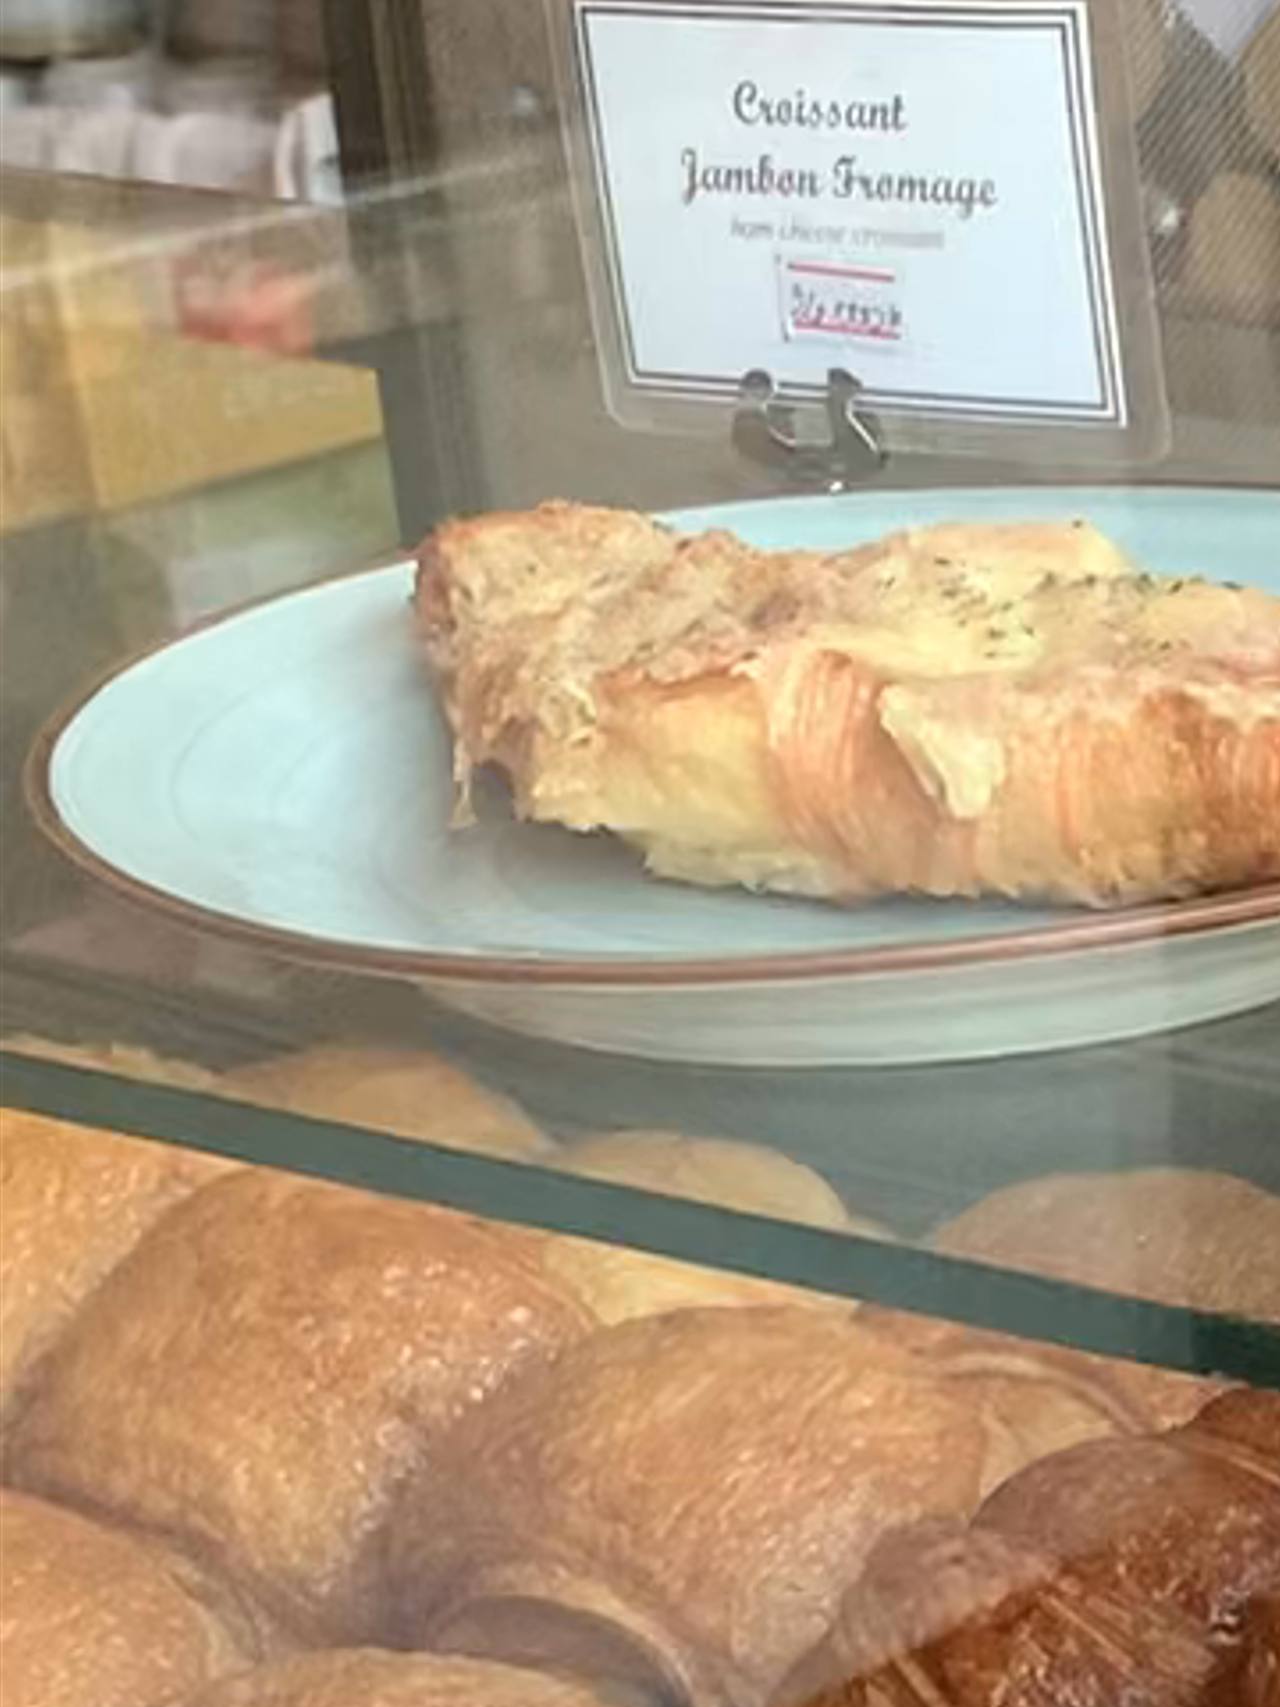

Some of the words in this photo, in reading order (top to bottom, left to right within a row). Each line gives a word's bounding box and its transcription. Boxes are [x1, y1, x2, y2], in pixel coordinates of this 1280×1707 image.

[732, 80, 906, 133] Croissant
[681, 148, 822, 205] Jambon
[832, 155, 997, 219] Fromage
